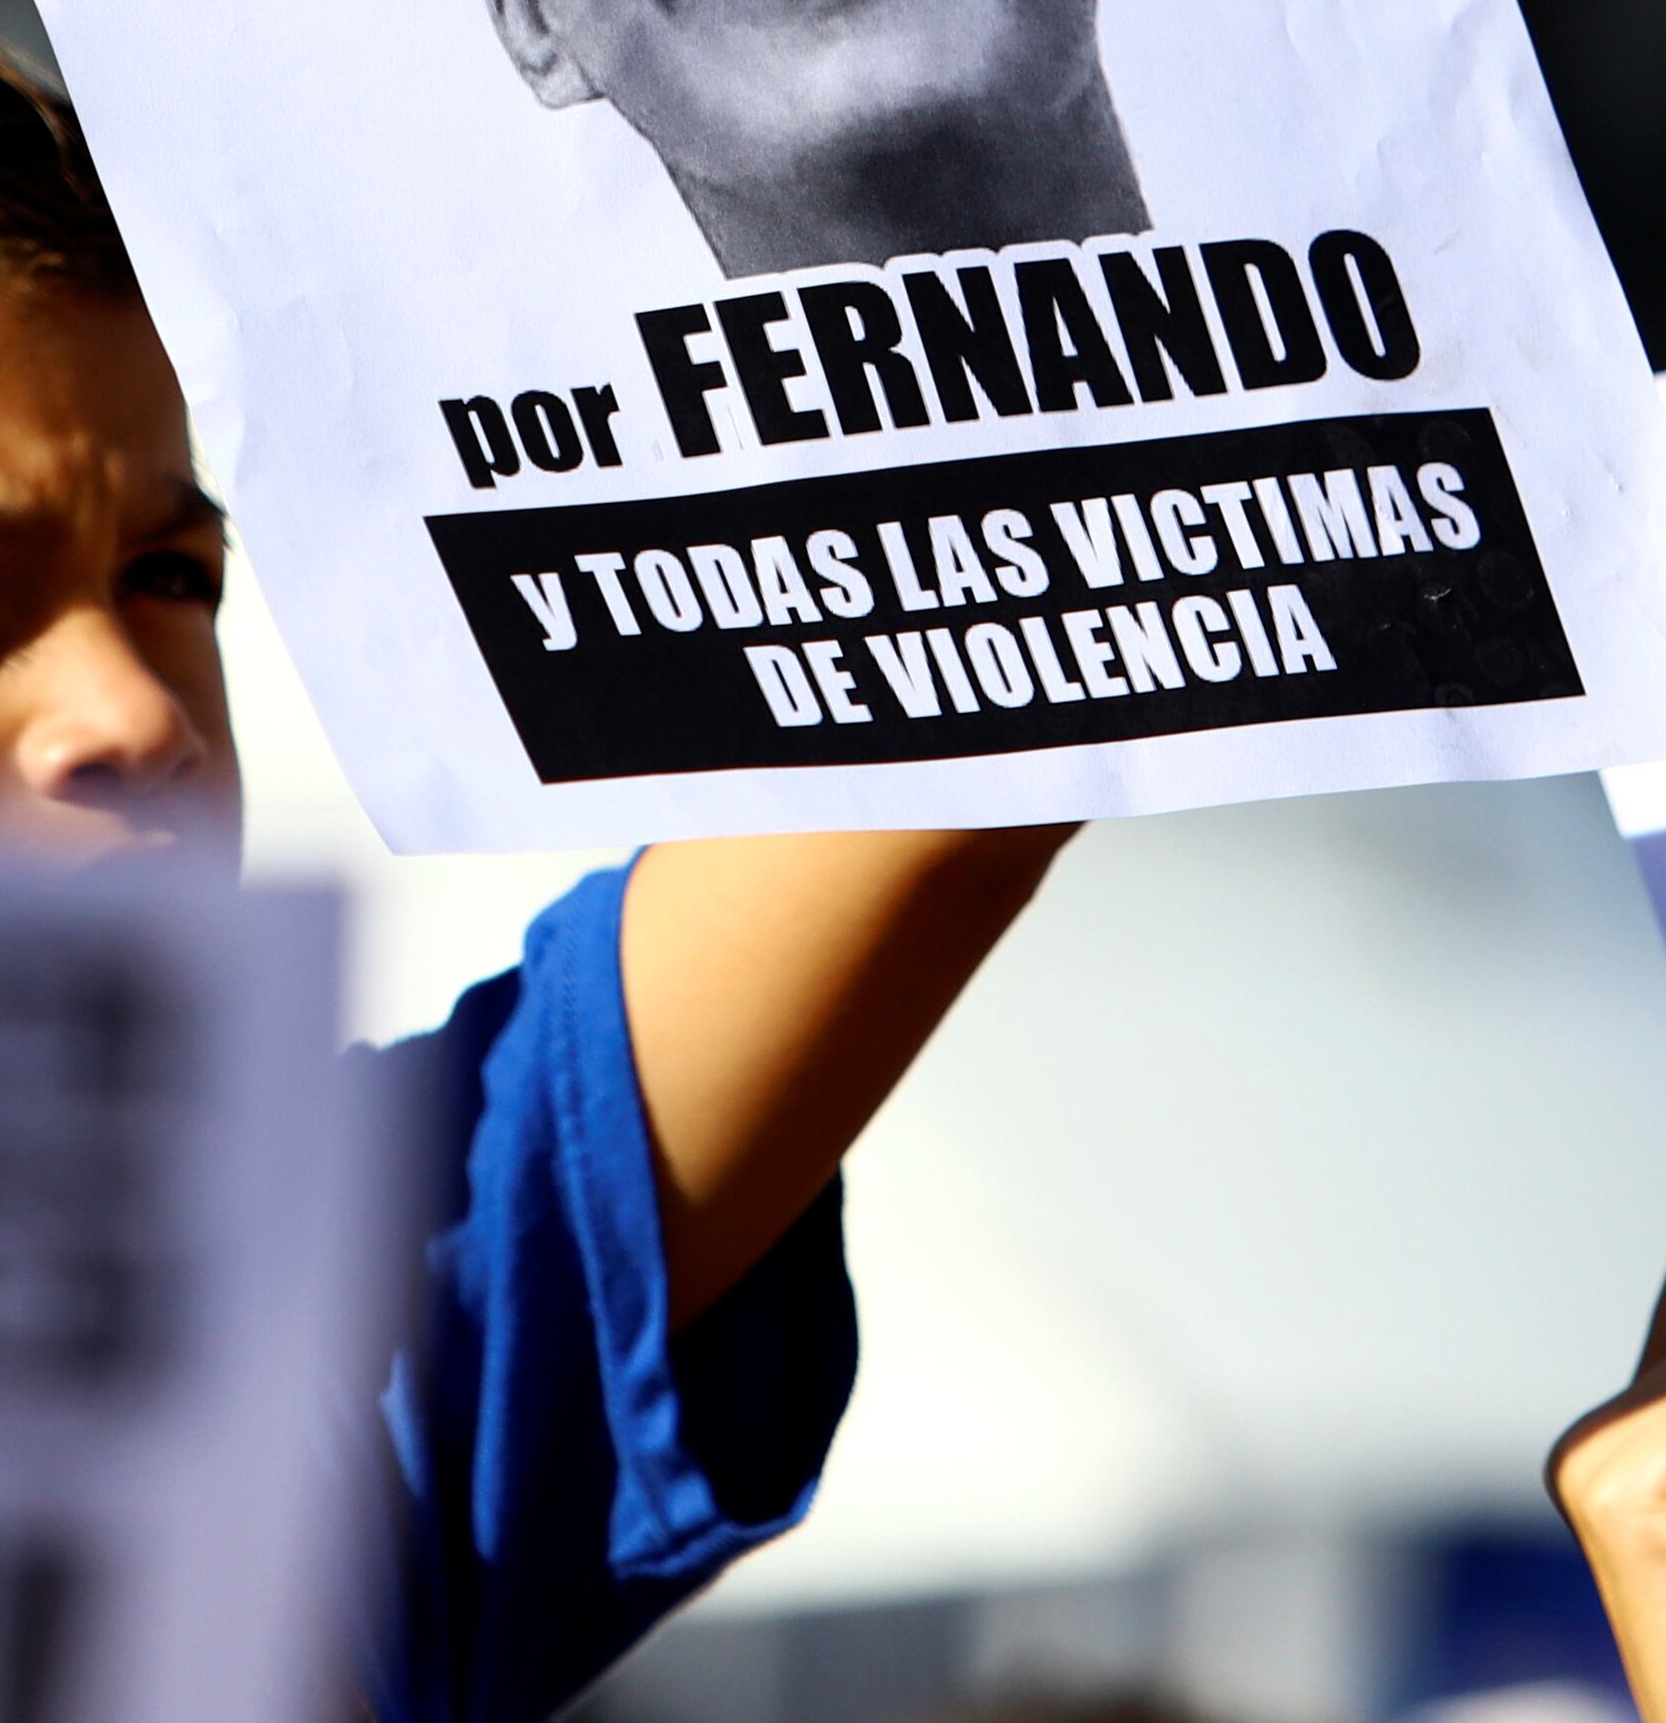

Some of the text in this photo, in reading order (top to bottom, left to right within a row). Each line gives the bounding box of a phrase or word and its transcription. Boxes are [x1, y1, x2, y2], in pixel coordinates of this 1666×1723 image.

[438, 229, 1422, 489] por FERNANDO
[511, 463, 1481, 652] y TODAS LAS VICTIMAS
[745, 584, 1336, 729] DE VIOLENCIA
